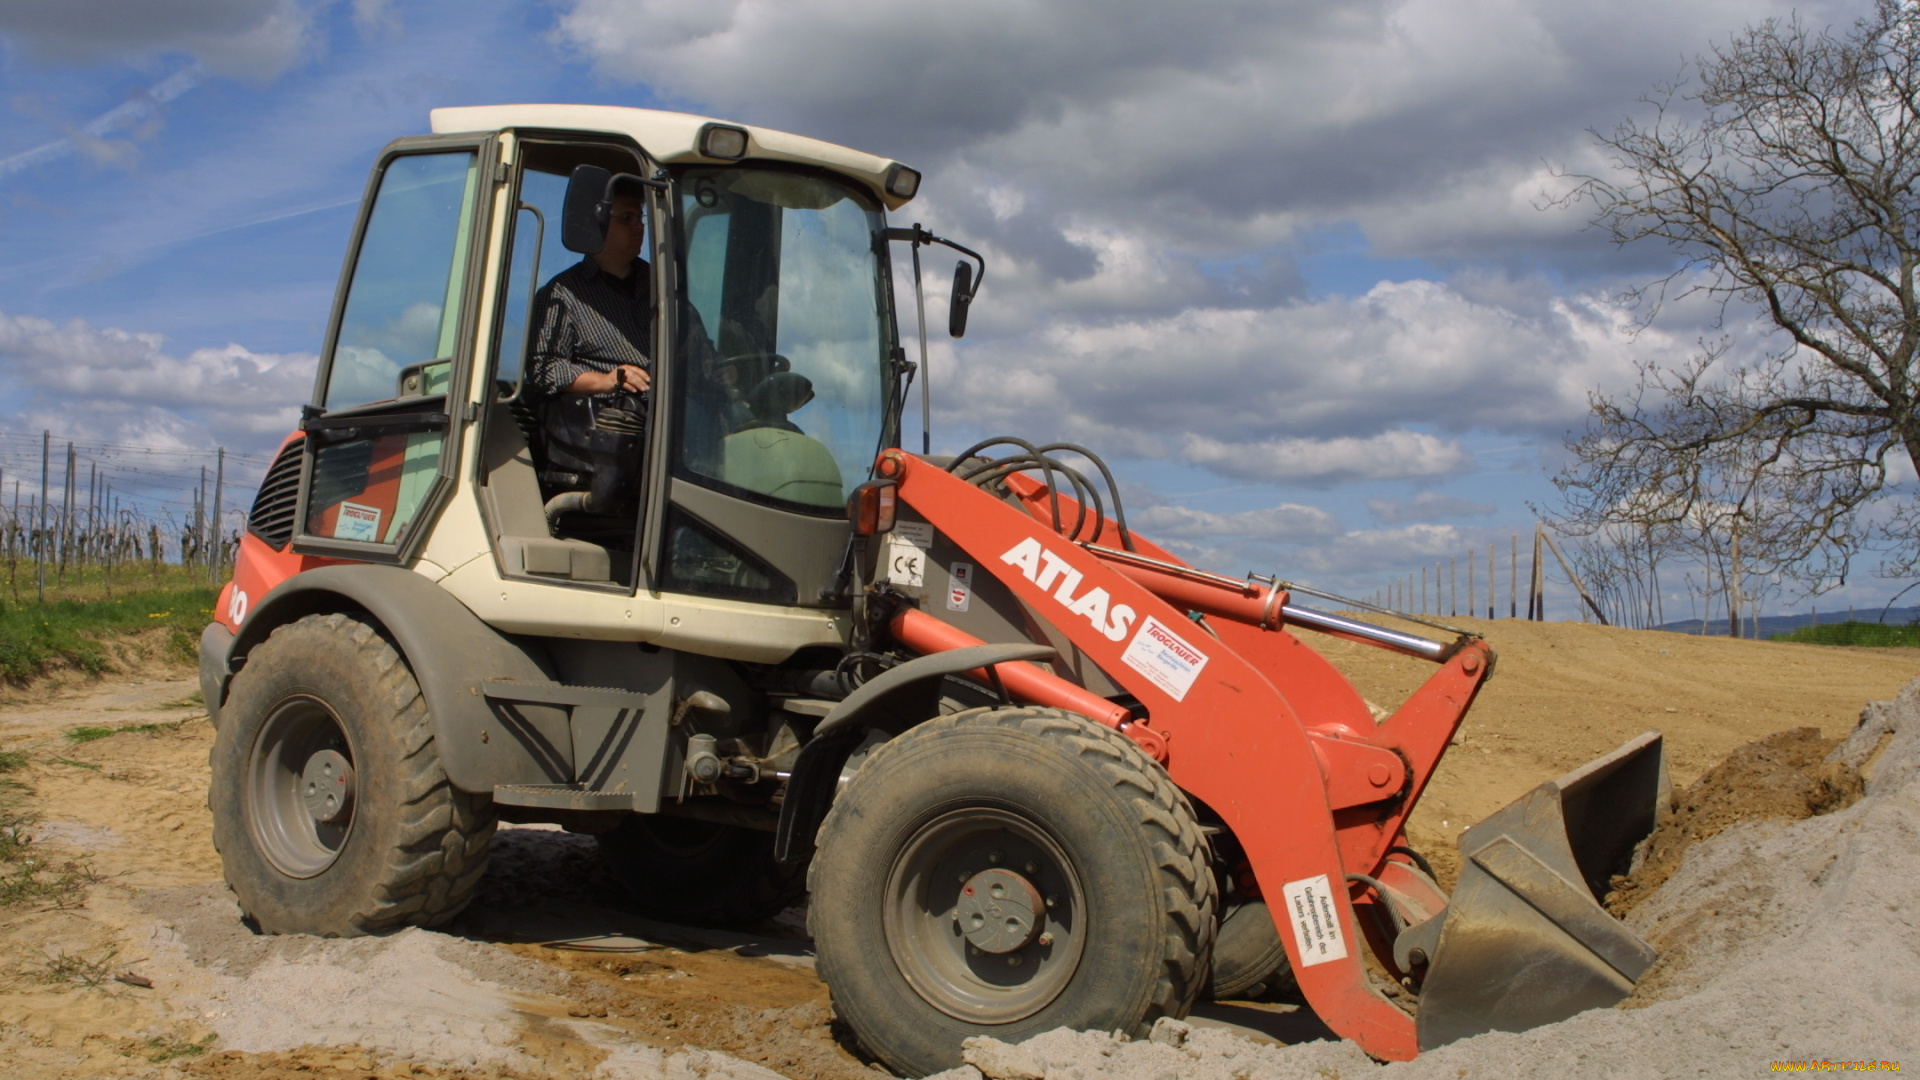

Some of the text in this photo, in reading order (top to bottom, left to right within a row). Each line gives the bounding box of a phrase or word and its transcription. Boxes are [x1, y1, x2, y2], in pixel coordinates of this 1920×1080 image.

[694, 175, 719, 209] 6
[894, 555, 921, 577] CE
[999, 536, 1137, 642] ATLAS
[1146, 622, 1203, 667] TROGLAUER
[1294, 895, 1304, 918] Laders
[1329, 930, 1336, 939] im
[1319, 942, 1327, 954] des
